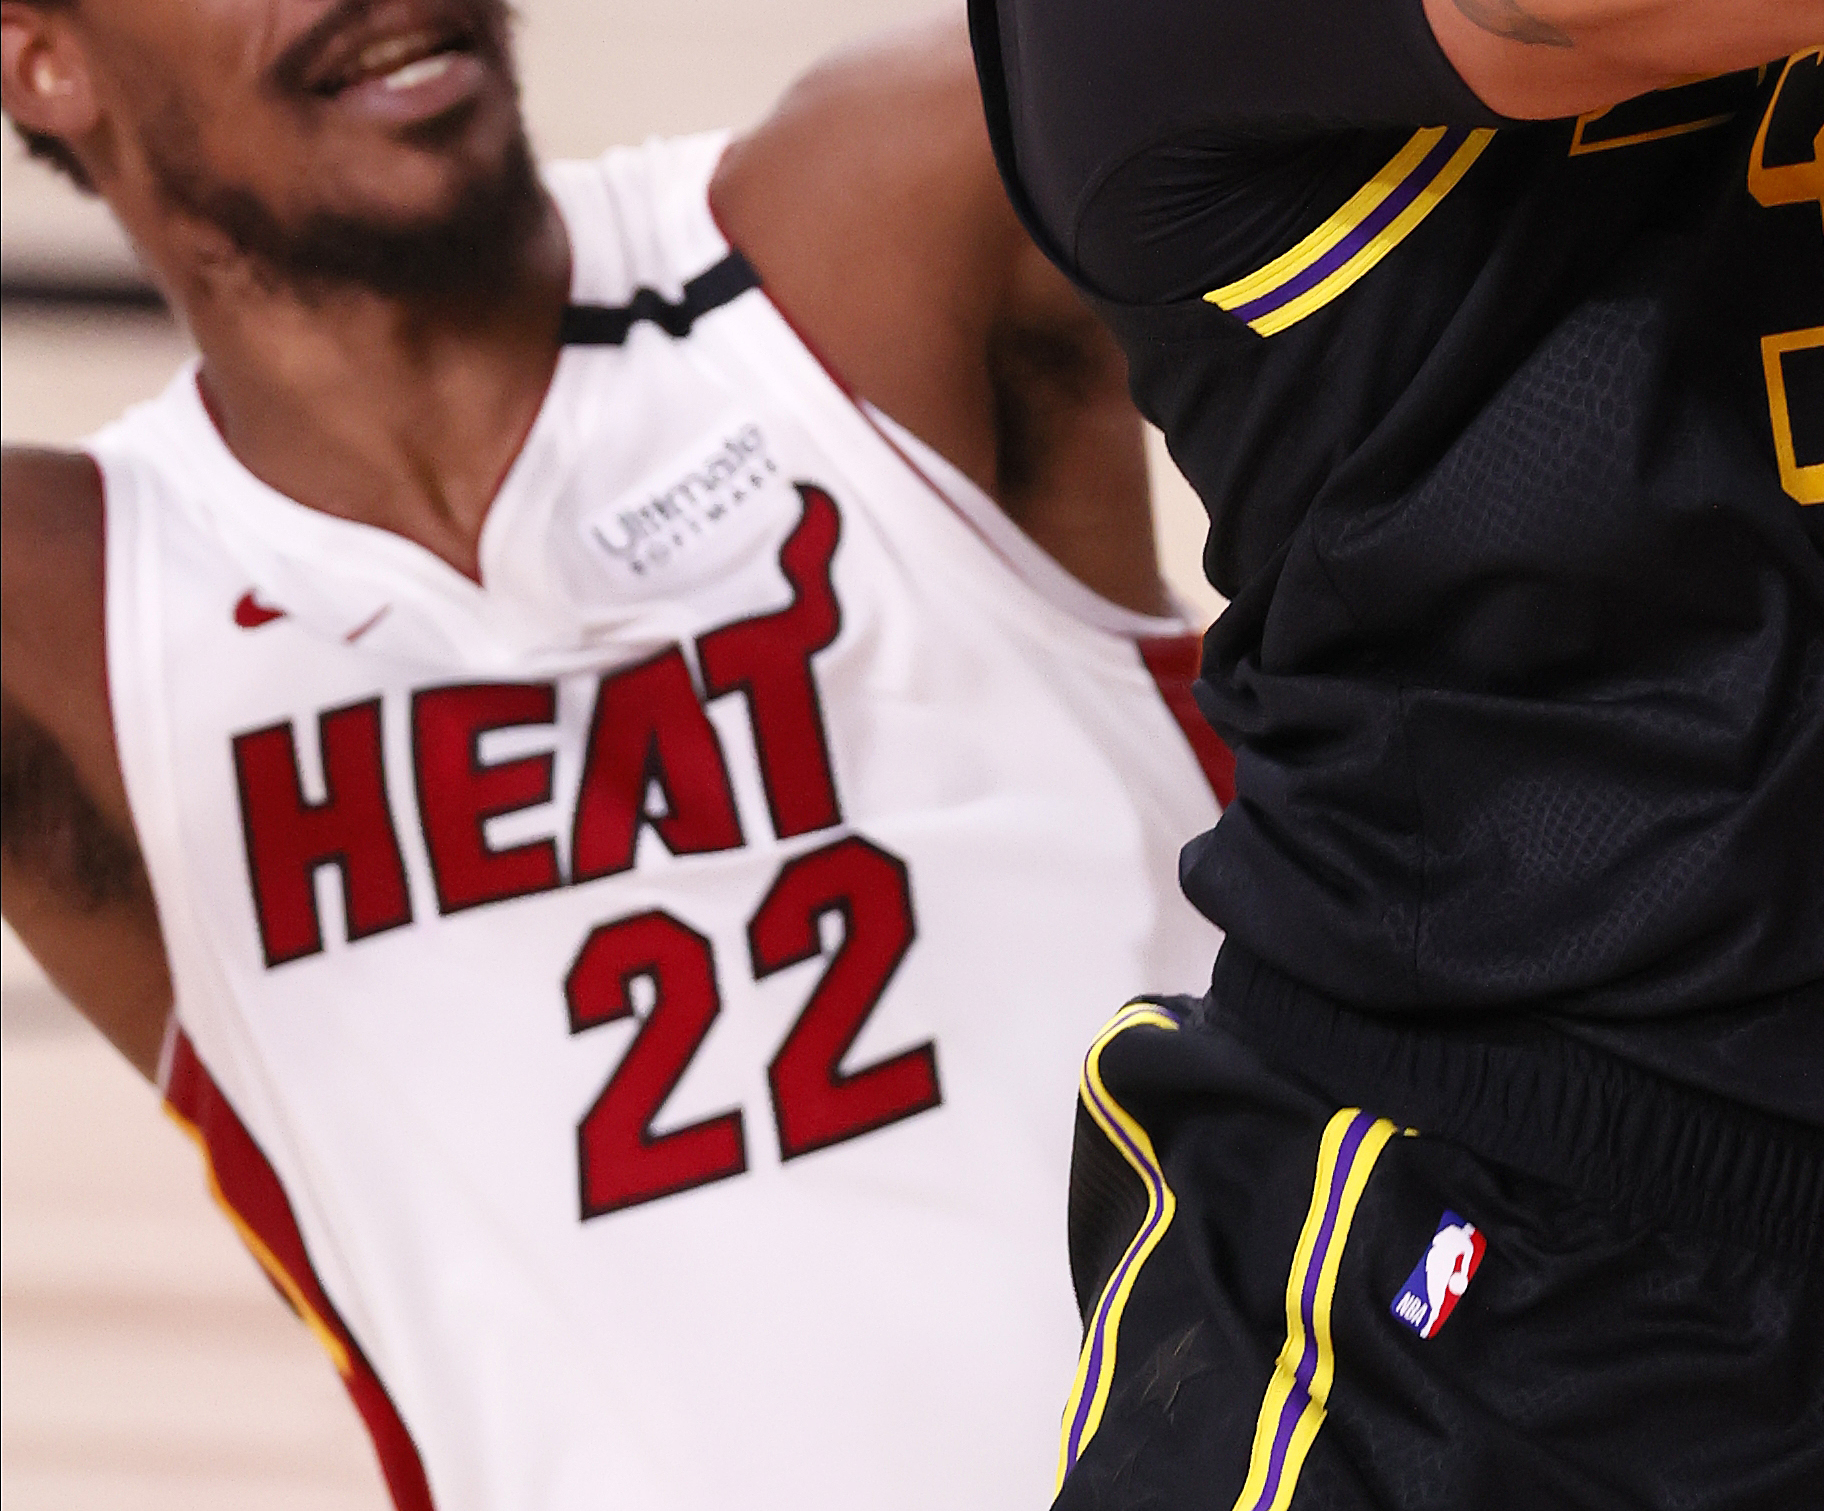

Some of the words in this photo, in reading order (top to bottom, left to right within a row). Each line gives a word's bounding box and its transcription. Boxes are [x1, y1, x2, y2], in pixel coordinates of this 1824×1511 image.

[232, 480, 844, 970] HEAT
[564, 834, 944, 1223] 22
[1395, 1290, 1428, 1328] NBA
